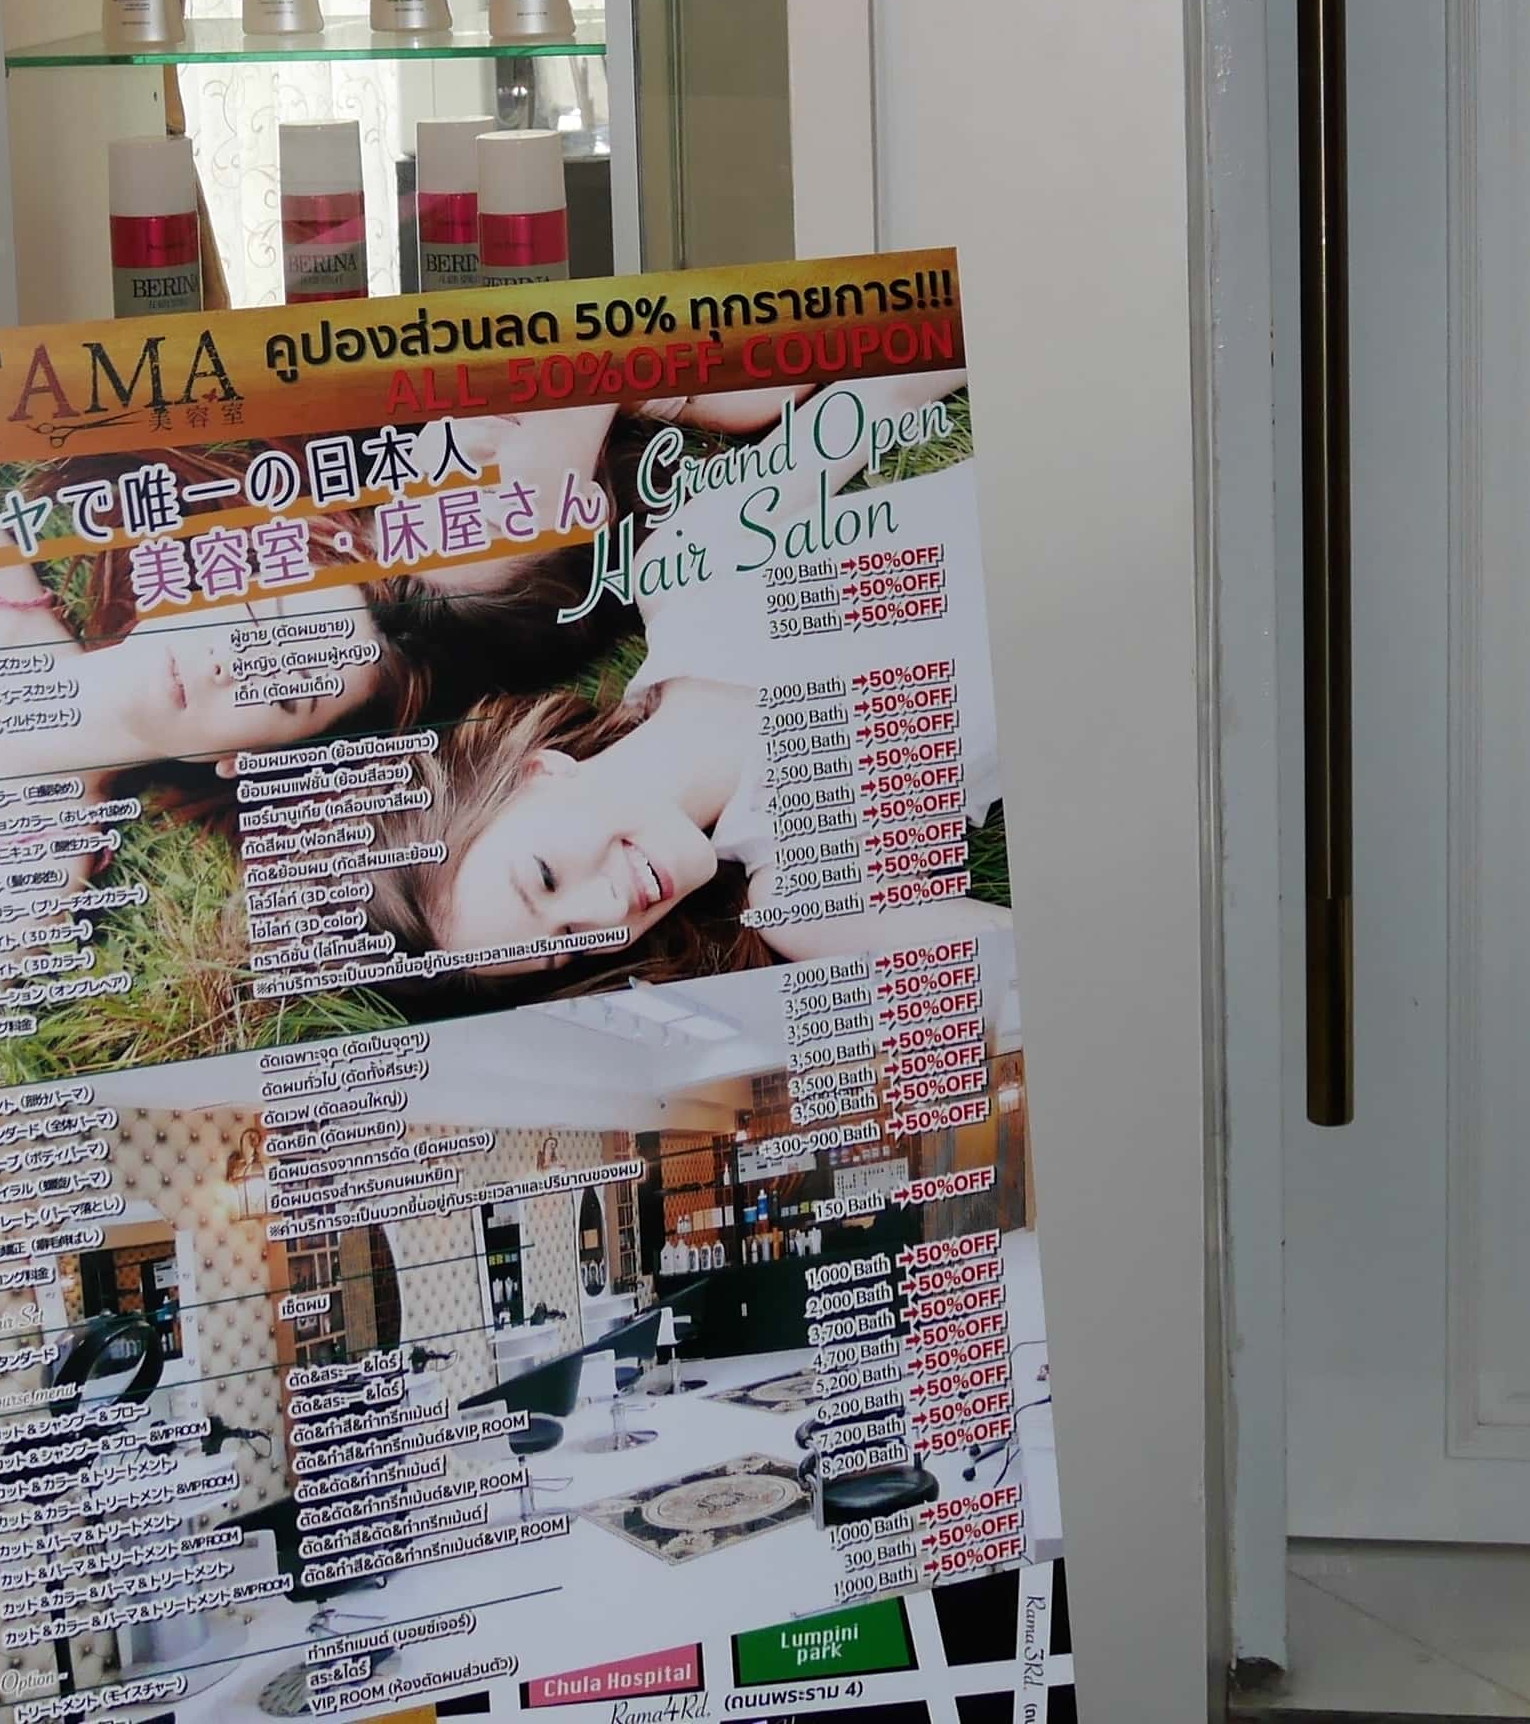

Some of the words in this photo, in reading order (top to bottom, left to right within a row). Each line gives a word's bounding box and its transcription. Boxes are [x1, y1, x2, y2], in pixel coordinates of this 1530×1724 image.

[289, 253, 357, 274] BERINA
[266, 308, 559, 384] คูปองส่วนลด
[575, 295, 676, 341] 50%
[690, 270, 954, 343] ทุกรายการ!!!
[388, 363, 488, 414] ALL
[508, 339, 724, 404] 50%OFF
[741, 319, 955, 380] COUPON
[641, 400, 796, 524] Grand
[814, 391, 949, 469] Open
[559, 514, 711, 621] Hair
[737, 471, 898, 572] Salon
[765, 566, 793, 582] 700
[798, 560, 833, 577] Bath
[858, 546, 939, 571] 50%OFF
[767, 592, 795, 608] 900
[801, 587, 835, 604] Bath
[860, 572, 940, 598] 50%OFF
[769, 617, 798, 634] 350
[803, 613, 837, 630] Bath
[862, 597, 943, 623] 50%OFF
[759, 684, 802, 703] 2,000
[807, 677, 841, 694] Bath
[869, 661, 950, 687] 50%OFF
[762, 712, 804, 732] 2,000
[809, 706, 843, 723] Bath
[871, 687, 952, 714] 50%OFF
[766, 738, 806, 757] 1,500
[811, 731, 845, 748] Bath
[873, 713, 954, 739] 50%OFF
[766, 765, 808, 784] 2,500
[813, 758, 848, 775] Bath
[876, 740, 956, 766] 50%OFF
[768, 792, 810, 811] 4,000
[815, 786, 850, 802] Bath
[878, 766, 958, 792] 50%OFF
[773, 817, 812, 836] 1,000
[818, 811, 853, 828] Bath
[880, 792, 961, 818] 50%OFF
[775, 845, 815, 864] 1,000
[820, 839, 855, 857] Bath
[882, 821, 963, 847] 50%OFF
[775, 872, 817, 891] 2,500
[822, 866, 857, 883] Bath
[884, 846, 965, 873] 50%OFF
[825, 896, 859, 914] Bath
[887, 876, 967, 903] 50%OFF
[783, 968, 825, 988] 2,000
[830, 961, 865, 978] Bath
[893, 940, 973, 968] 50%OFF
[785, 994, 827, 1015] 3,500
[832, 987, 867, 1005] Bath
[895, 967, 975, 995] 50%OFF
[787, 1020, 829, 1041] 3,500
[834, 1013, 869, 1031] Bath
[897, 993, 977, 1020] 50%OFF
[789, 1048, 831, 1067] 3,500
[836, 1041, 871, 1059] Bath
[899, 1020, 979, 1047] 50%OFF
[791, 1075, 833, 1095] 3,500
[838, 1067, 873, 1086] Bath
[901, 1046, 981, 1074] 50%OFF
[793, 1100, 836, 1121] 3,500
[840, 1094, 875, 1112] Bath
[903, 1072, 983, 1100] 50%OFF
[843, 1124, 878, 1142] Bath
[905, 1101, 986, 1130] 50%OFF
[848, 1194, 882, 1213] Bath
[911, 1170, 991, 1199] 50%OFF
[808, 1266, 849, 1286] 1,000
[854, 1257, 889, 1275] Bath
[917, 1234, 996, 1263] 50%OFF
[807, 1295, 851, 1315] 2,000
[856, 1285, 891, 1303] Bath
[919, 1261, 998, 1291] 50%OFF
[809, 1322, 853, 1342] 3,700
[858, 1313, 893, 1331] Bath
[921, 1288, 1001, 1318] 50%OFF
[813, 1349, 855, 1370] 4,700
[860, 1339, 895, 1358] Bath
[923, 1315, 1003, 1344] 50%OFF
[817, 1374, 857, 1394] 5,200
[862, 1365, 897, 1383] Bath
[925, 1339, 1005, 1369] 50%OFF
[818, 1399, 859, 1419] 6,200
[865, 1391, 899, 1410] Bath
[927, 1365, 1007, 1395] 50%OFF
[821, 1428, 862, 1448] 7,200
[867, 1420, 902, 1439] Bath
[929, 1392, 1009, 1423] 50%OFF
[822, 1456, 864, 1476] 8,200
[869, 1446, 904, 1465] Bath
[931, 1419, 1011, 1450] 50%OFF
[829, 1524, 869, 1544] 1,000
[875, 1516, 909, 1534] Bath
[937, 1488, 1017, 1519] 50%OFF
[844, 1551, 872, 1567] 300
[877, 1542, 911, 1560] Bath
[939, 1513, 1019, 1545] 50%OFF
[834, 1577, 874, 1597] 1,000
[879, 1568, 913, 1586] Bath
[941, 1539, 1021, 1571] 50%OFF
[781, 1622, 859, 1650] Lumpini
[797, 1642, 842, 1665] park
[312, 1696, 336, 1712] VIP
[340, 1687, 385, 1705] ROOM
[544, 1673, 602, 1698] Chula
[608, 1663, 691, 1688] Hospital
